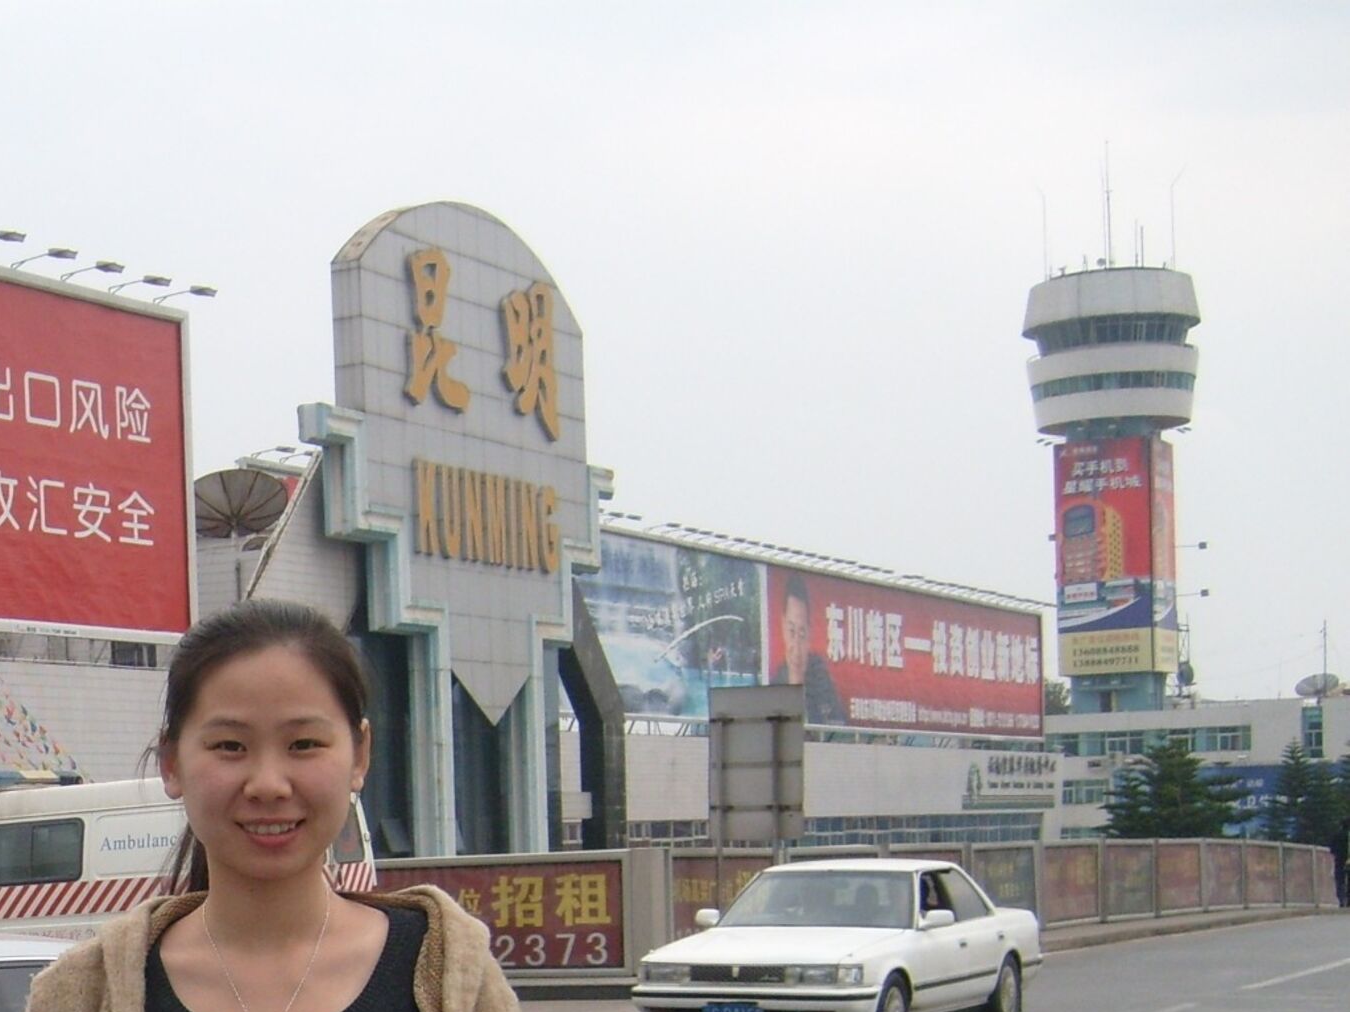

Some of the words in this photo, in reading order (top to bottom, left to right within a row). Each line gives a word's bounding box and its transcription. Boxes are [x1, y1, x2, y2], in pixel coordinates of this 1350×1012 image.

[403, 247, 561, 441] 昆明
[412, 457, 560, 574] KUNMING
[491, 873, 612, 928] 招租
[495, 932, 609, 967] 2373
